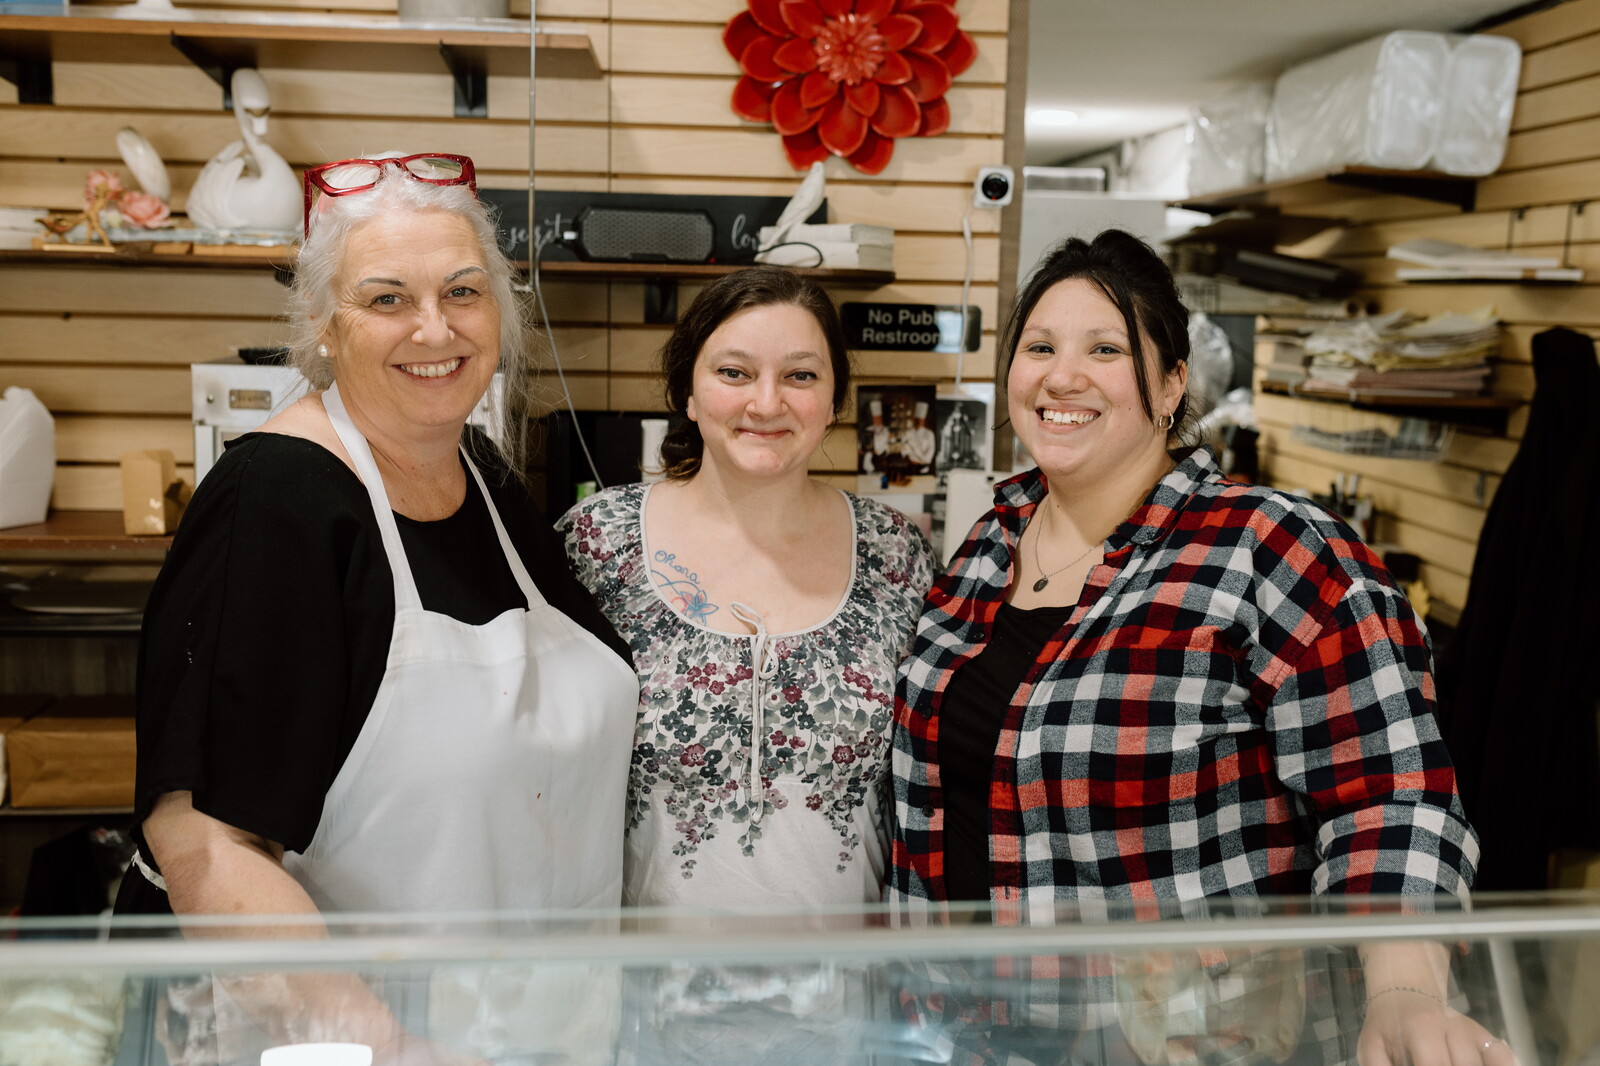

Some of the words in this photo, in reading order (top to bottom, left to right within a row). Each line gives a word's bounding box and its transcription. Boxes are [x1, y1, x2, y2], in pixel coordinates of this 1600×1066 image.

[731, 214, 760, 251] lov
[868, 309, 893, 324] No
[654, 549, 701, 585] Ohana
